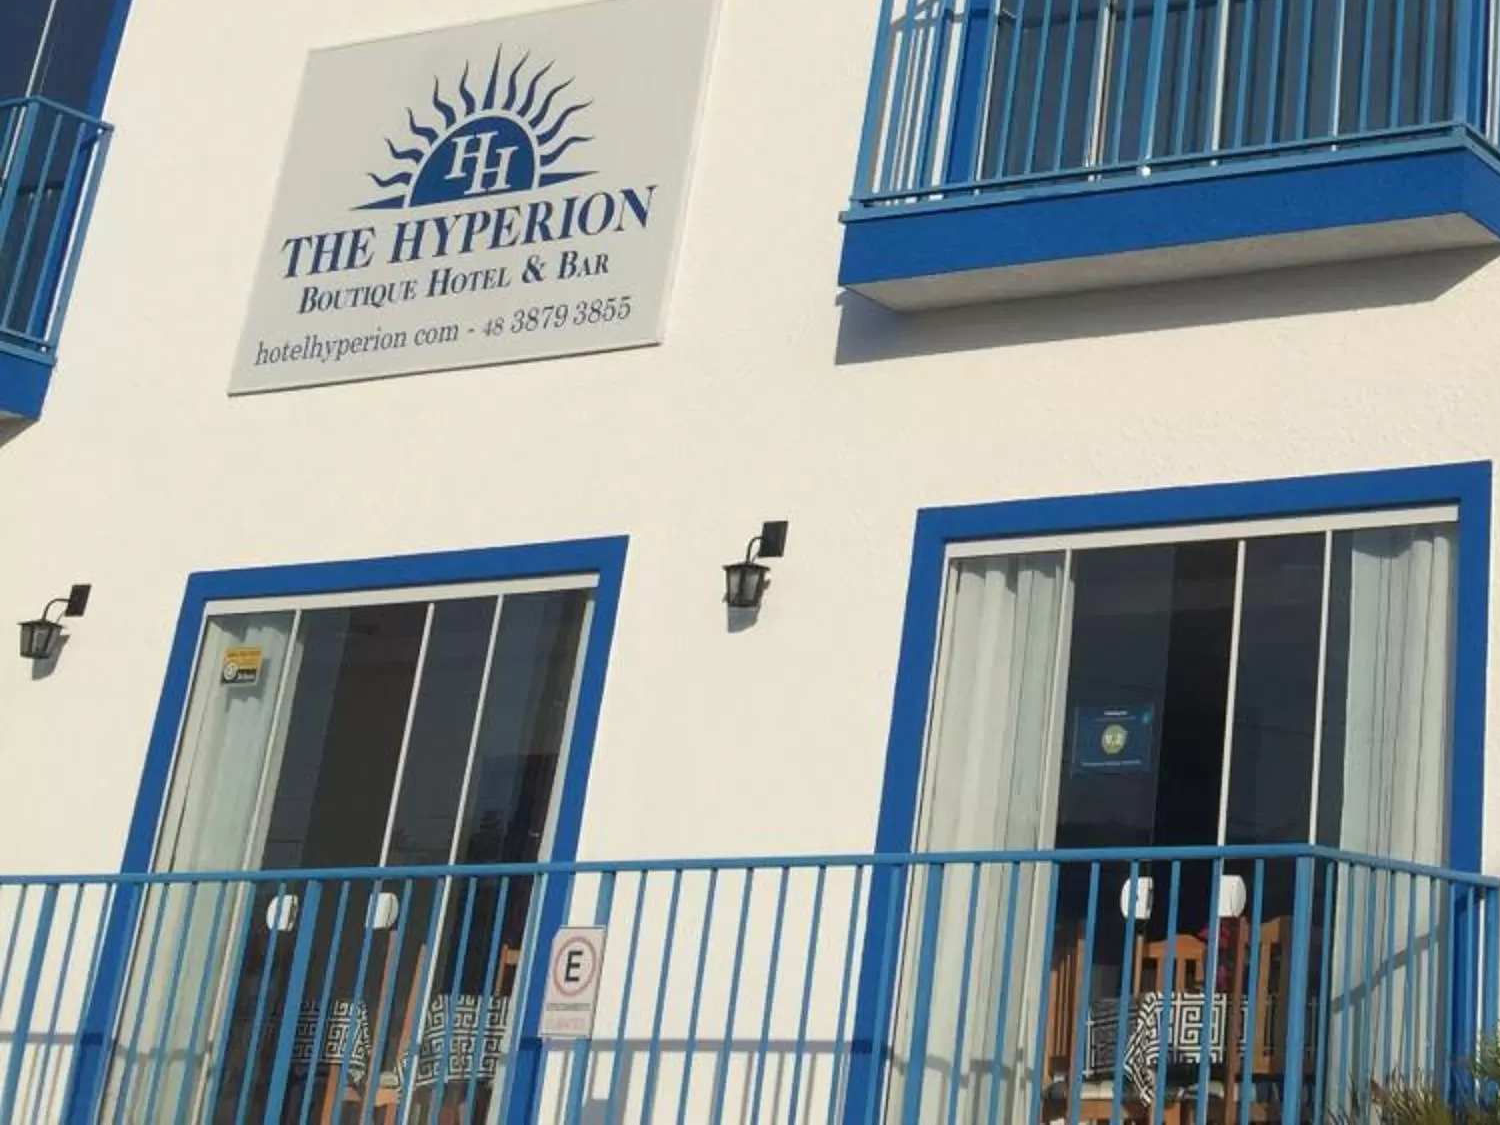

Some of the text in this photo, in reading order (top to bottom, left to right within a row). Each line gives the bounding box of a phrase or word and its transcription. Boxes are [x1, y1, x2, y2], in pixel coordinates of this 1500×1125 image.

[280, 184, 659, 279] THE HYPERION
[296, 249, 610, 315] BOUTIQUE HOTEL & BAR
[510, 303, 569, 335] 3879
[573, 295, 632, 326] 3855
[564, 950, 584, 982] E
